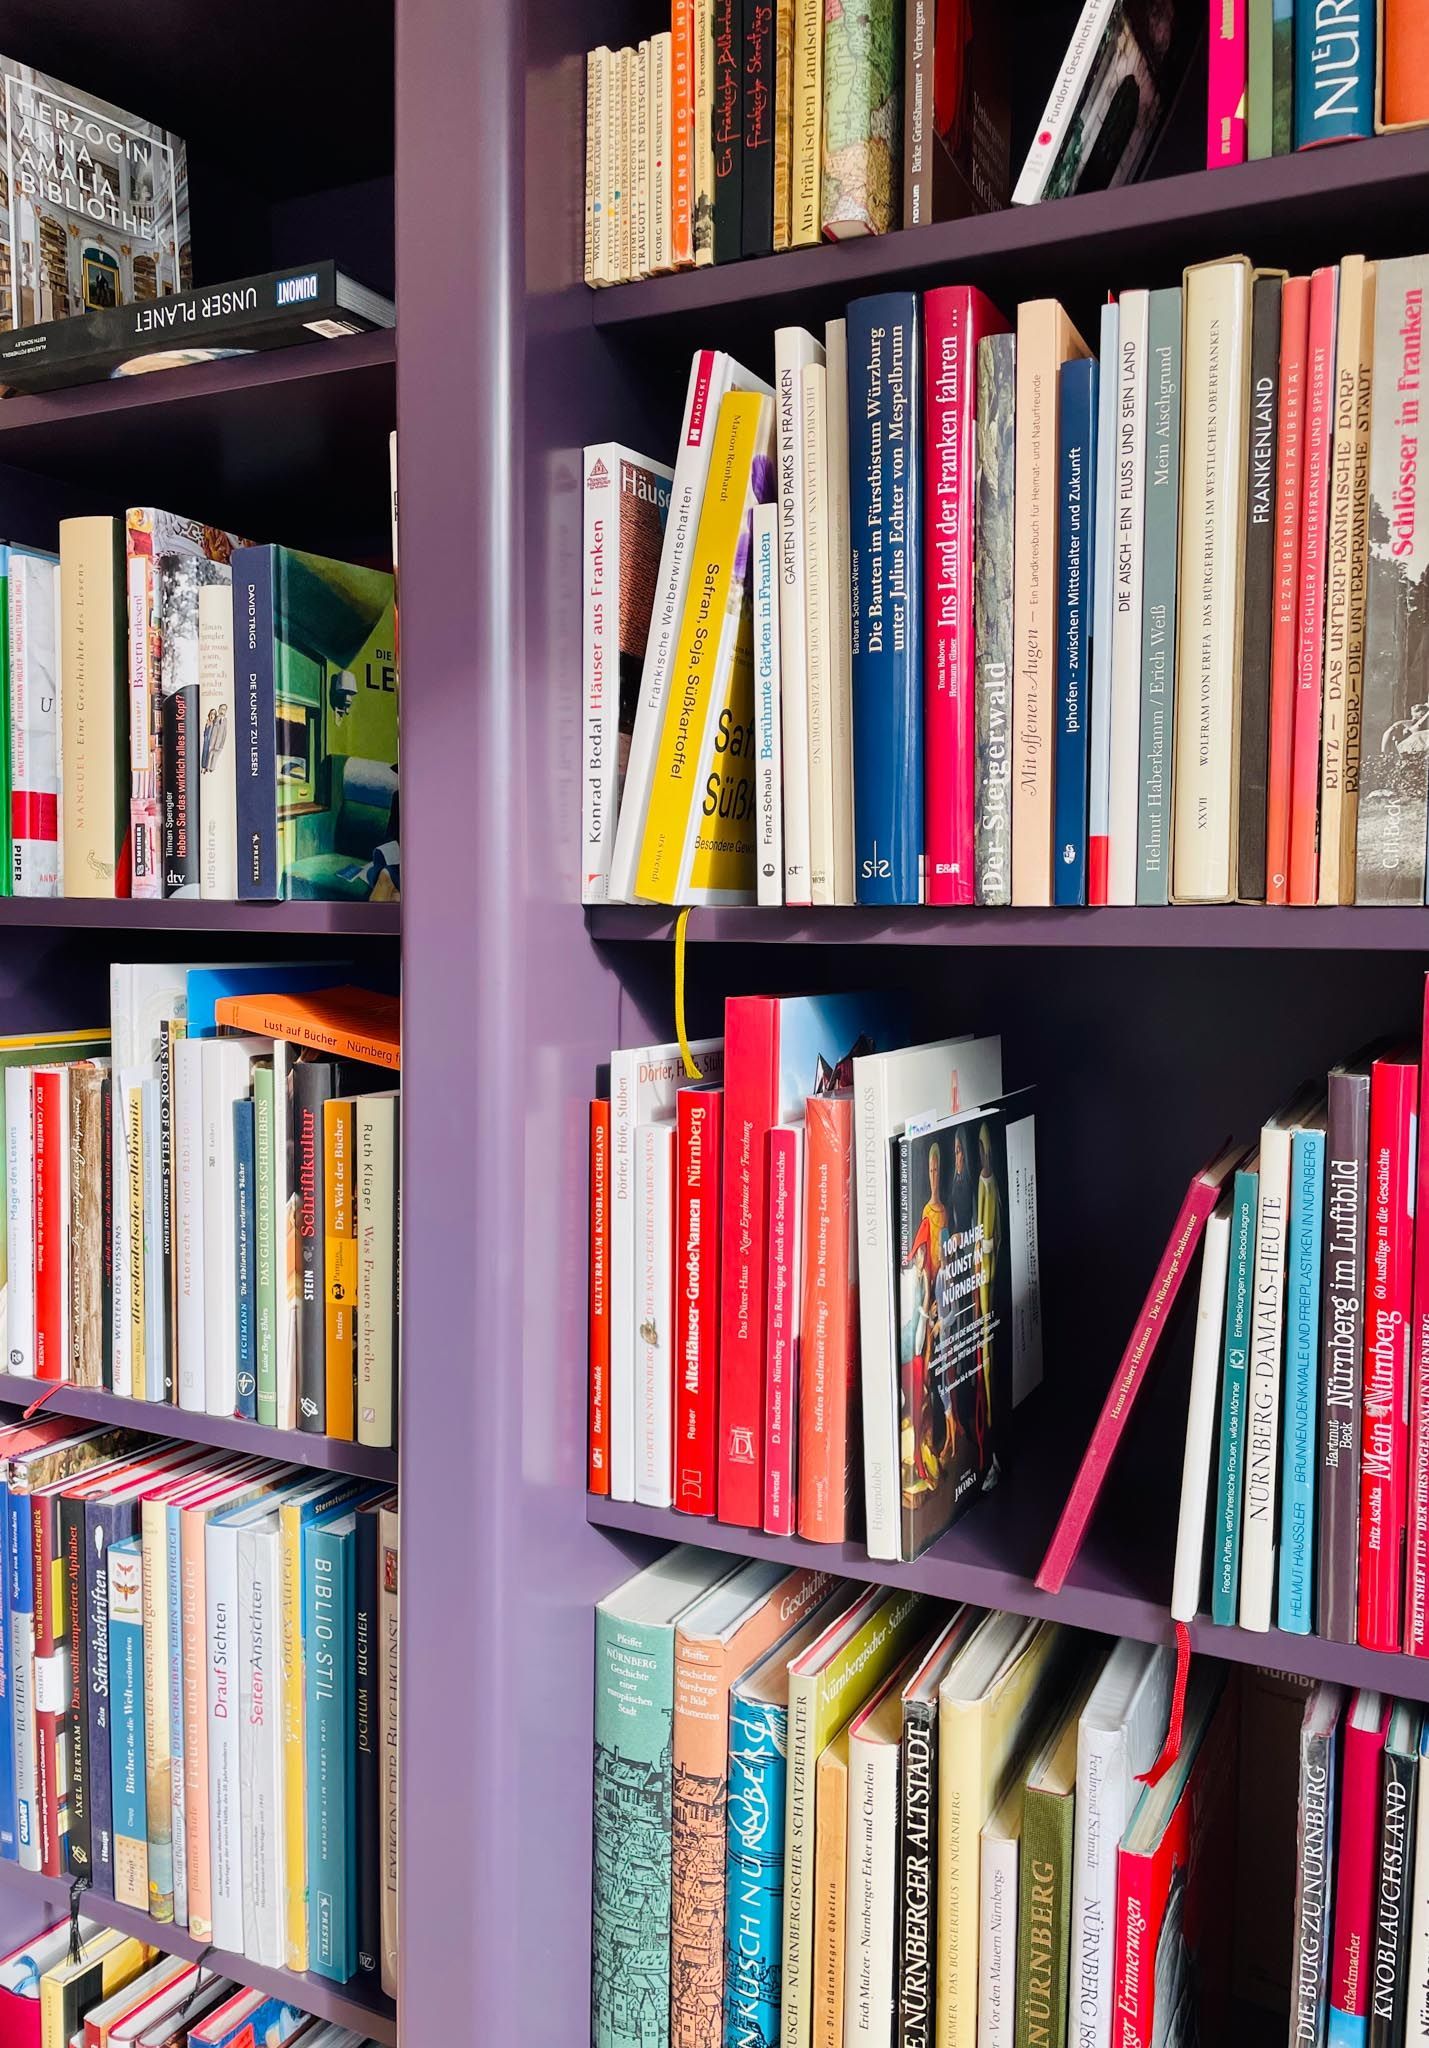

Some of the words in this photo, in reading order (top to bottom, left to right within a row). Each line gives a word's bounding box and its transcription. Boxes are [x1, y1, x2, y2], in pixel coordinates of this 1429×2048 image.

[1047, 78, 1073, 124] Fundort
[1066, 12, 1096, 75] Geschichte
[913, 73, 923, 142] Grießhammer
[18, 96, 149, 167] HERZOGIN
[18, 120, 94, 168] ANNA
[18, 148, 116, 202] AMALIA
[913, 145, 922, 172] Birke
[20, 172, 168, 248] BIBLIOTHEK
[203, 286, 258, 320] UNSER
[277, 275, 318, 304] DUMONT
[135, 299, 197, 332] PLANET
[1124, 341, 1135, 380] LAND
[1397, 289, 1422, 392] Franken
[866, 328, 886, 418] Würzburg
[888, 325, 907, 442] Mespelbrunn
[938, 336, 958, 403] fahren
[780, 369, 794, 434] FRANKEN
[1122, 387, 1134, 418] SEIN
[1155, 347, 1173, 437] Aischgrund
[1394, 400, 1418, 425] in
[781, 436, 795, 450] IN
[939, 407, 957, 496] Franken
[1122, 424, 1134, 455] UND
[1253, 377, 1273, 523] FRANKENLAND
[781, 452, 795, 496] PARKS
[866, 422, 883, 526] Fürstbistum
[891, 447, 904, 480] von
[1068, 447, 1081, 501] Zukunft
[1121, 461, 1133, 499] FLUSS
[1154, 444, 1169, 485] Mein
[781, 498, 796, 531] UND
[889, 485, 905, 544] Echter
[938, 499, 957, 534] der
[1391, 434, 1417, 556] Schlösser
[1068, 505, 1080, 530] und
[590, 520, 604, 596] Franken
[780, 533, 797, 585] GÄRTEN
[868, 530, 884, 554] im
[76, 563, 84, 606] Lesens
[759, 532, 772, 601] Franken
[889, 548, 907, 600] Julius
[939, 540, 957, 594] Land
[1068, 536, 1080, 605] Mittelalter
[247, 584, 255, 615] DAVID
[648, 631, 670, 708] Fränkische
[662, 485, 692, 625] Weiberwirtschaften
[697, 564, 719, 623] Safran,
[759, 602, 772, 618] in
[868, 558, 884, 622] Bauten
[938, 598, 957, 626] Ins
[1119, 592, 1130, 612] DIE
[76, 612, 84, 633] des
[248, 617, 256, 649] TRIGG
[590, 604, 603, 636] aus
[868, 623, 884, 653] Die
[890, 604, 905, 651] unter
[1068, 610, 1079, 669] zwischen
[1151, 605, 1165, 646] Weiß
[688, 629, 709, 669] Soja,
[758, 622, 773, 678] Gärten
[76, 640, 85, 711] Geschichte
[588, 644, 604, 709] Häuser
[1150, 651, 1164, 694] Erich
[175, 695, 186, 720] Kopf?
[175, 723, 185, 733] im
[670, 675, 699, 779] Süßkartoffel
[758, 680, 773, 760] Berühmte
[1066, 681, 1078, 732] Iphofen
[76, 718, 85, 745] Eine
[175, 736, 185, 757] alles
[250, 730, 257, 744] ZU
[588, 718, 602, 769] Bedal
[982, 662, 1009, 831] Steigerwald
[175, 760, 186, 792] wirklich
[250, 747, 258, 776] LESEN
[1148, 710, 1163, 806] Haberkamm
[76, 754, 85, 829] MANGUEL
[165, 791, 175, 828] Spengler
[176, 794, 186, 810] das
[588, 778, 603, 843] Konrad
[763, 769, 774, 812] Schaub
[176, 812, 186, 827] Sie
[763, 815, 774, 845] Franz
[165, 830, 173, 857] Tilman
[176, 829, 187, 857] Haben
[1146, 813, 1161, 871] Helmut
[982, 839, 1006, 894] Der
[161, 1031, 169, 1059] DAS
[161, 1062, 169, 1103] BOOK
[162, 1108, 169, 1127] OF
[162, 1131, 170, 1175] KELLS
[258, 1099, 269, 1182] SCHREIBENS
[300, 1109, 316, 1236] Schriftkultur
[1377, 1148, 1390, 1204] Geschichte
[259, 1185, 269, 1209] DES
[1330, 1160, 1358, 1254] Luftbild
[1377, 1207, 1388, 1223] die
[259, 1212, 269, 1258] GLÜCK
[1377, 1226, 1388, 1236] in
[259, 1261, 269, 1286] DAS
[1330, 1260, 1356, 1291] im
[1375, 1240, 1390, 1283] Ausflüge
[303, 1270, 314, 1300] STEIN
[1375, 1286, 1387, 1299] 60
[1326, 1296, 1359, 1409] Nürnberg
[1363, 1310, 1402, 1409] Nürnberg
[1326, 1420, 1340, 1467] Hartmut
[1340, 1422, 1353, 1449] Beck
[1361, 1423, 1393, 1481] Mein
[1370, 1488, 1382, 1524] Aschka
[68, 1526, 79, 1580] Alphabet
[1369, 1527, 1381, 1550] Fritz
[70, 1583, 81, 1684] wohltemperierte
[92, 1570, 109, 1696] Schreibschriften
[71, 1686, 81, 1710] Das
[72, 1726, 83, 1781] BERTRAM
[74, 1786, 83, 1818] AXEL
[863, 1763, 875, 1815] Chörlein
[906, 1722, 930, 1849] ALTSTADT
[864, 1819, 872, 1841] und
[1300, 1765, 1325, 1896] NÜRNBERG
[862, 1844, 872, 1875] Erker
[788, 1844, 802, 1987] NÜRNBERGISCHER
[860, 1880, 873, 1947] Nürnberger
[1301, 1902, 1322, 1932] ZU
[1374, 1781, 1406, 2020] KNOBLAUCHSLAND
[901, 1855, 929, 2032] NÜRNBERGER
[1025, 1860, 1054, 2046] NÜRNBERG
[860, 1956, 873, 1999] Mulzer
[1299, 1937, 1319, 1999] BURG
[860, 2002, 869, 2030] Erich
[1298, 2003, 1316, 2041] DIE
